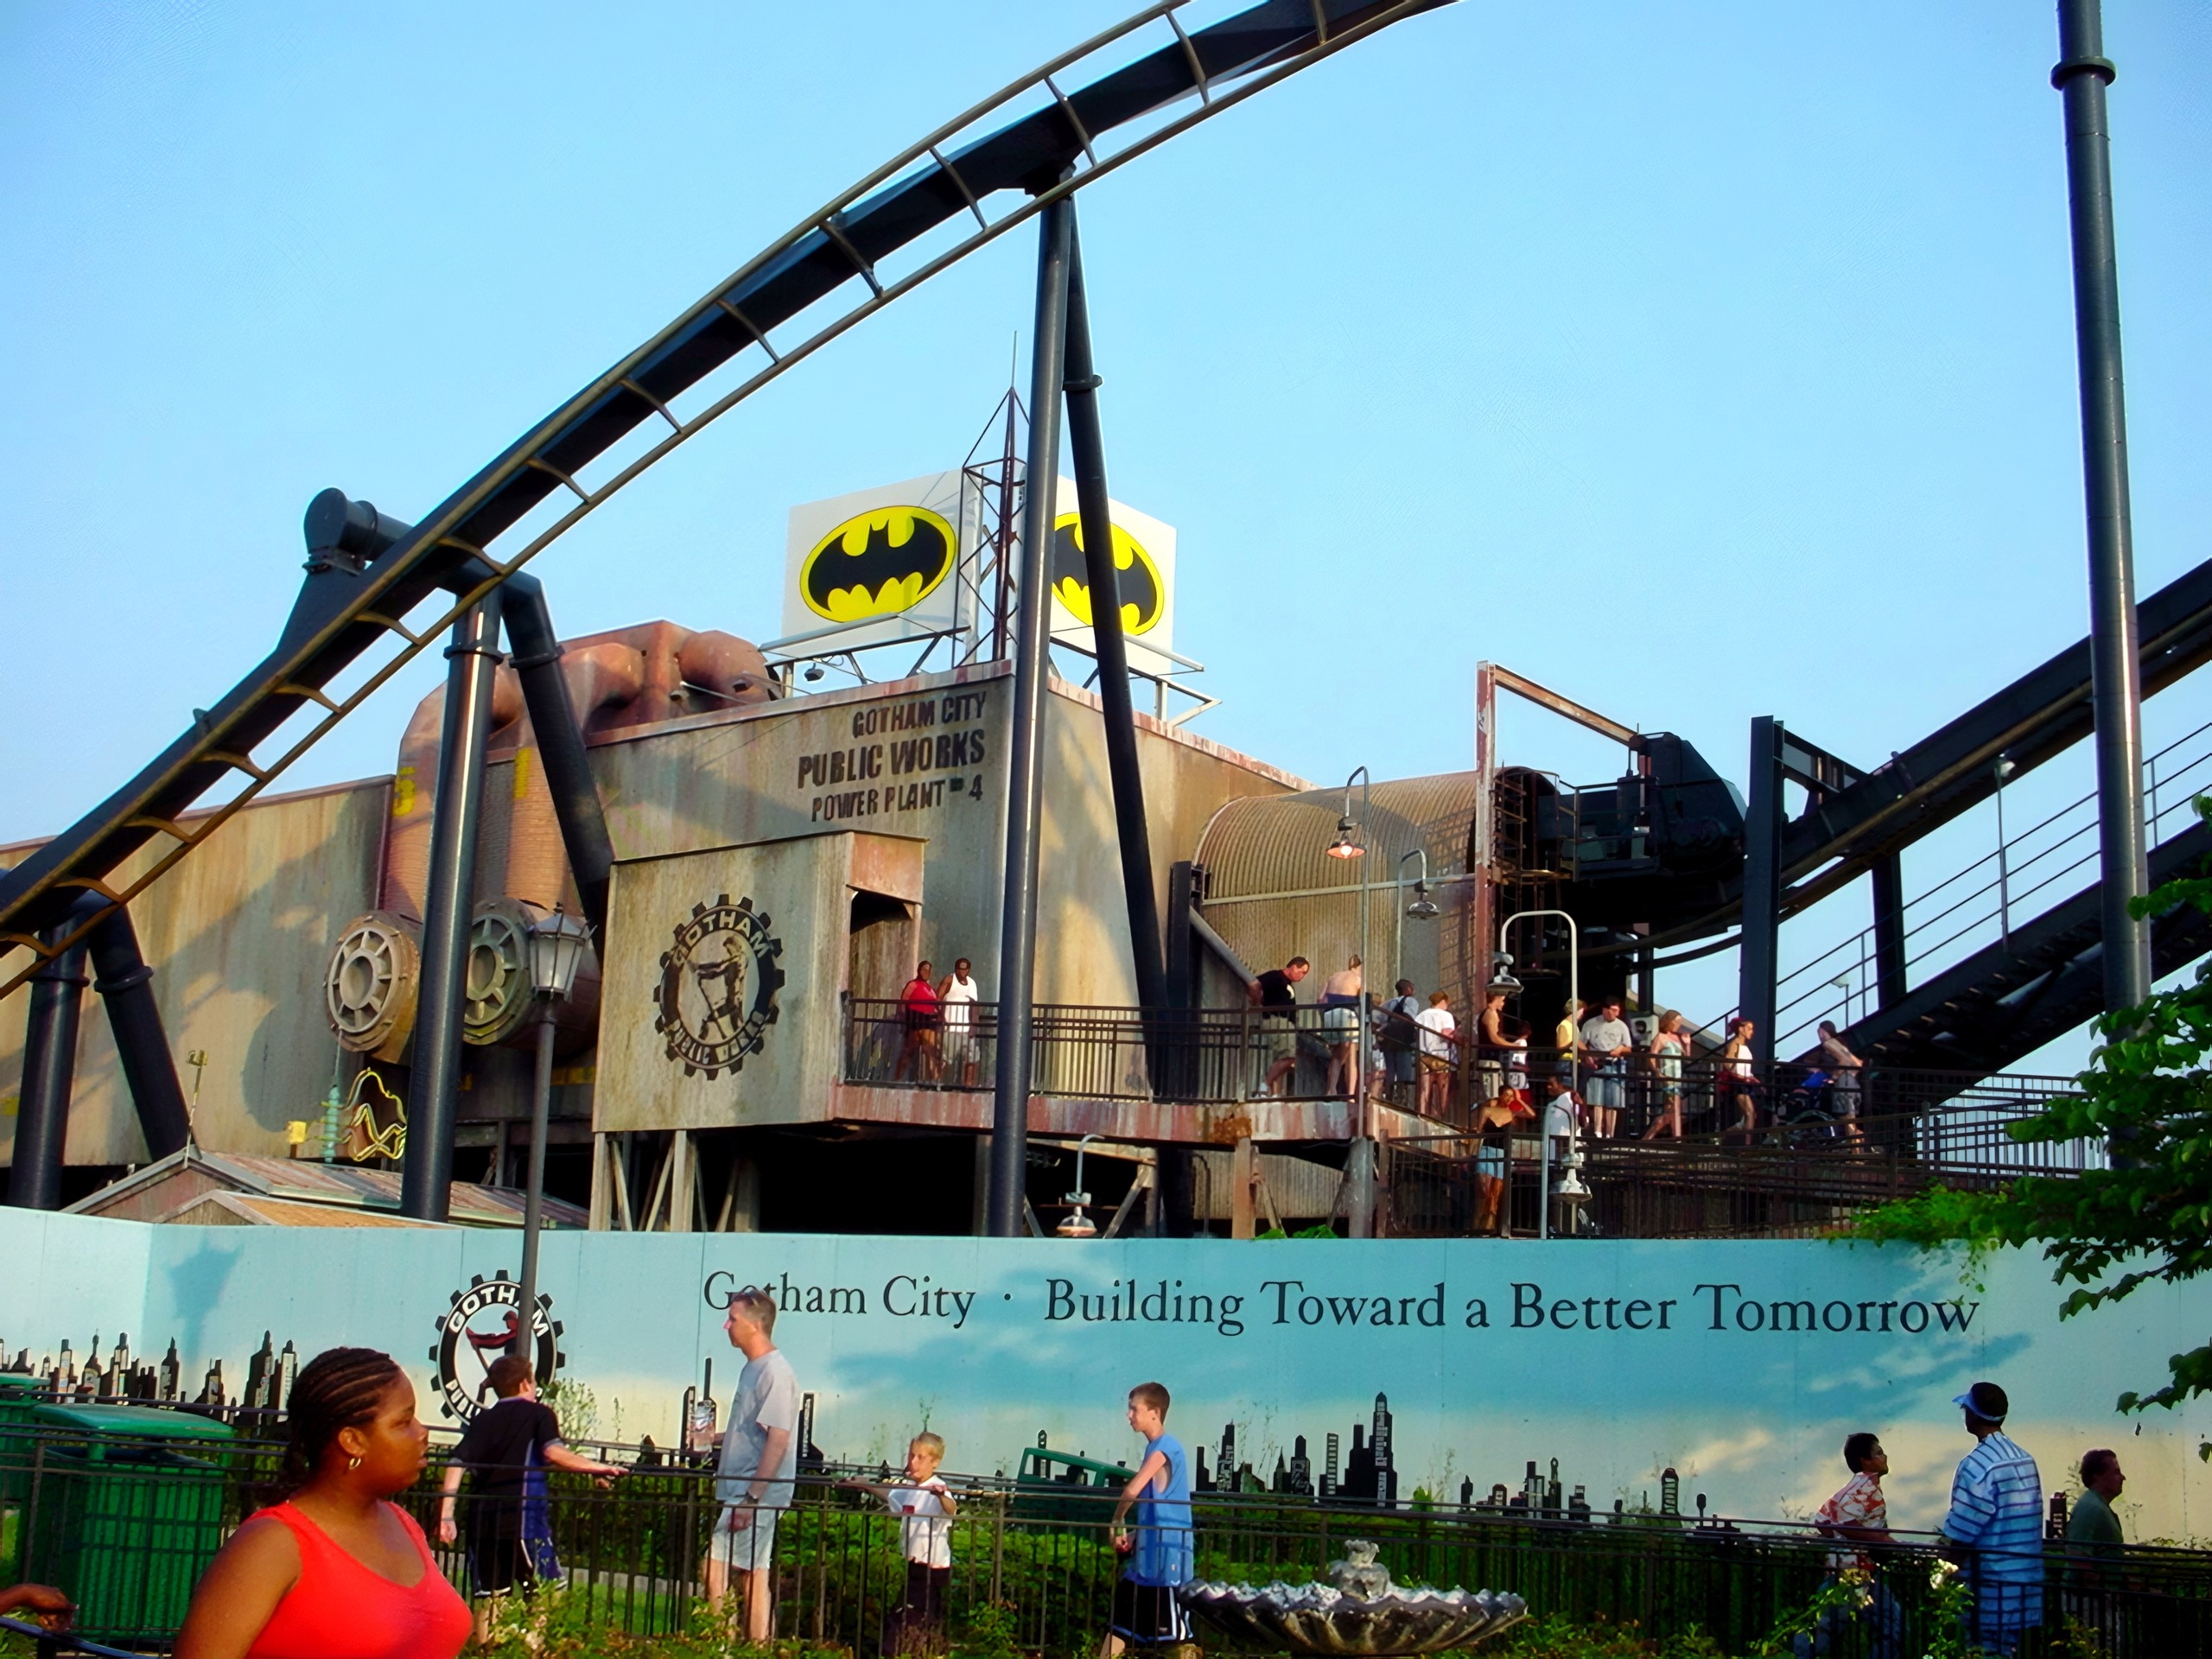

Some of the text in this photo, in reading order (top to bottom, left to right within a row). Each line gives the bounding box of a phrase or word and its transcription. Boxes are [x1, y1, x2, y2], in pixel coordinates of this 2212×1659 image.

[852, 692, 986, 738] GOTHAM CITY
[798, 728, 985, 789] PUBLIC WORKS
[811, 790, 878, 821] POWER
[885, 779, 945, 812] PLANT
[673, 912, 772, 964] GOTHAM
[448, 1285, 550, 1338] GOTHM
[882, 1275, 976, 1329] City
[1046, 1279, 1244, 1336] Building
[1260, 1281, 1444, 1327] Toward
[1465, 1299, 1490, 1327] a
[1510, 1283, 1676, 1330] Better
[1693, 1284, 1980, 1333] Tomorrow
